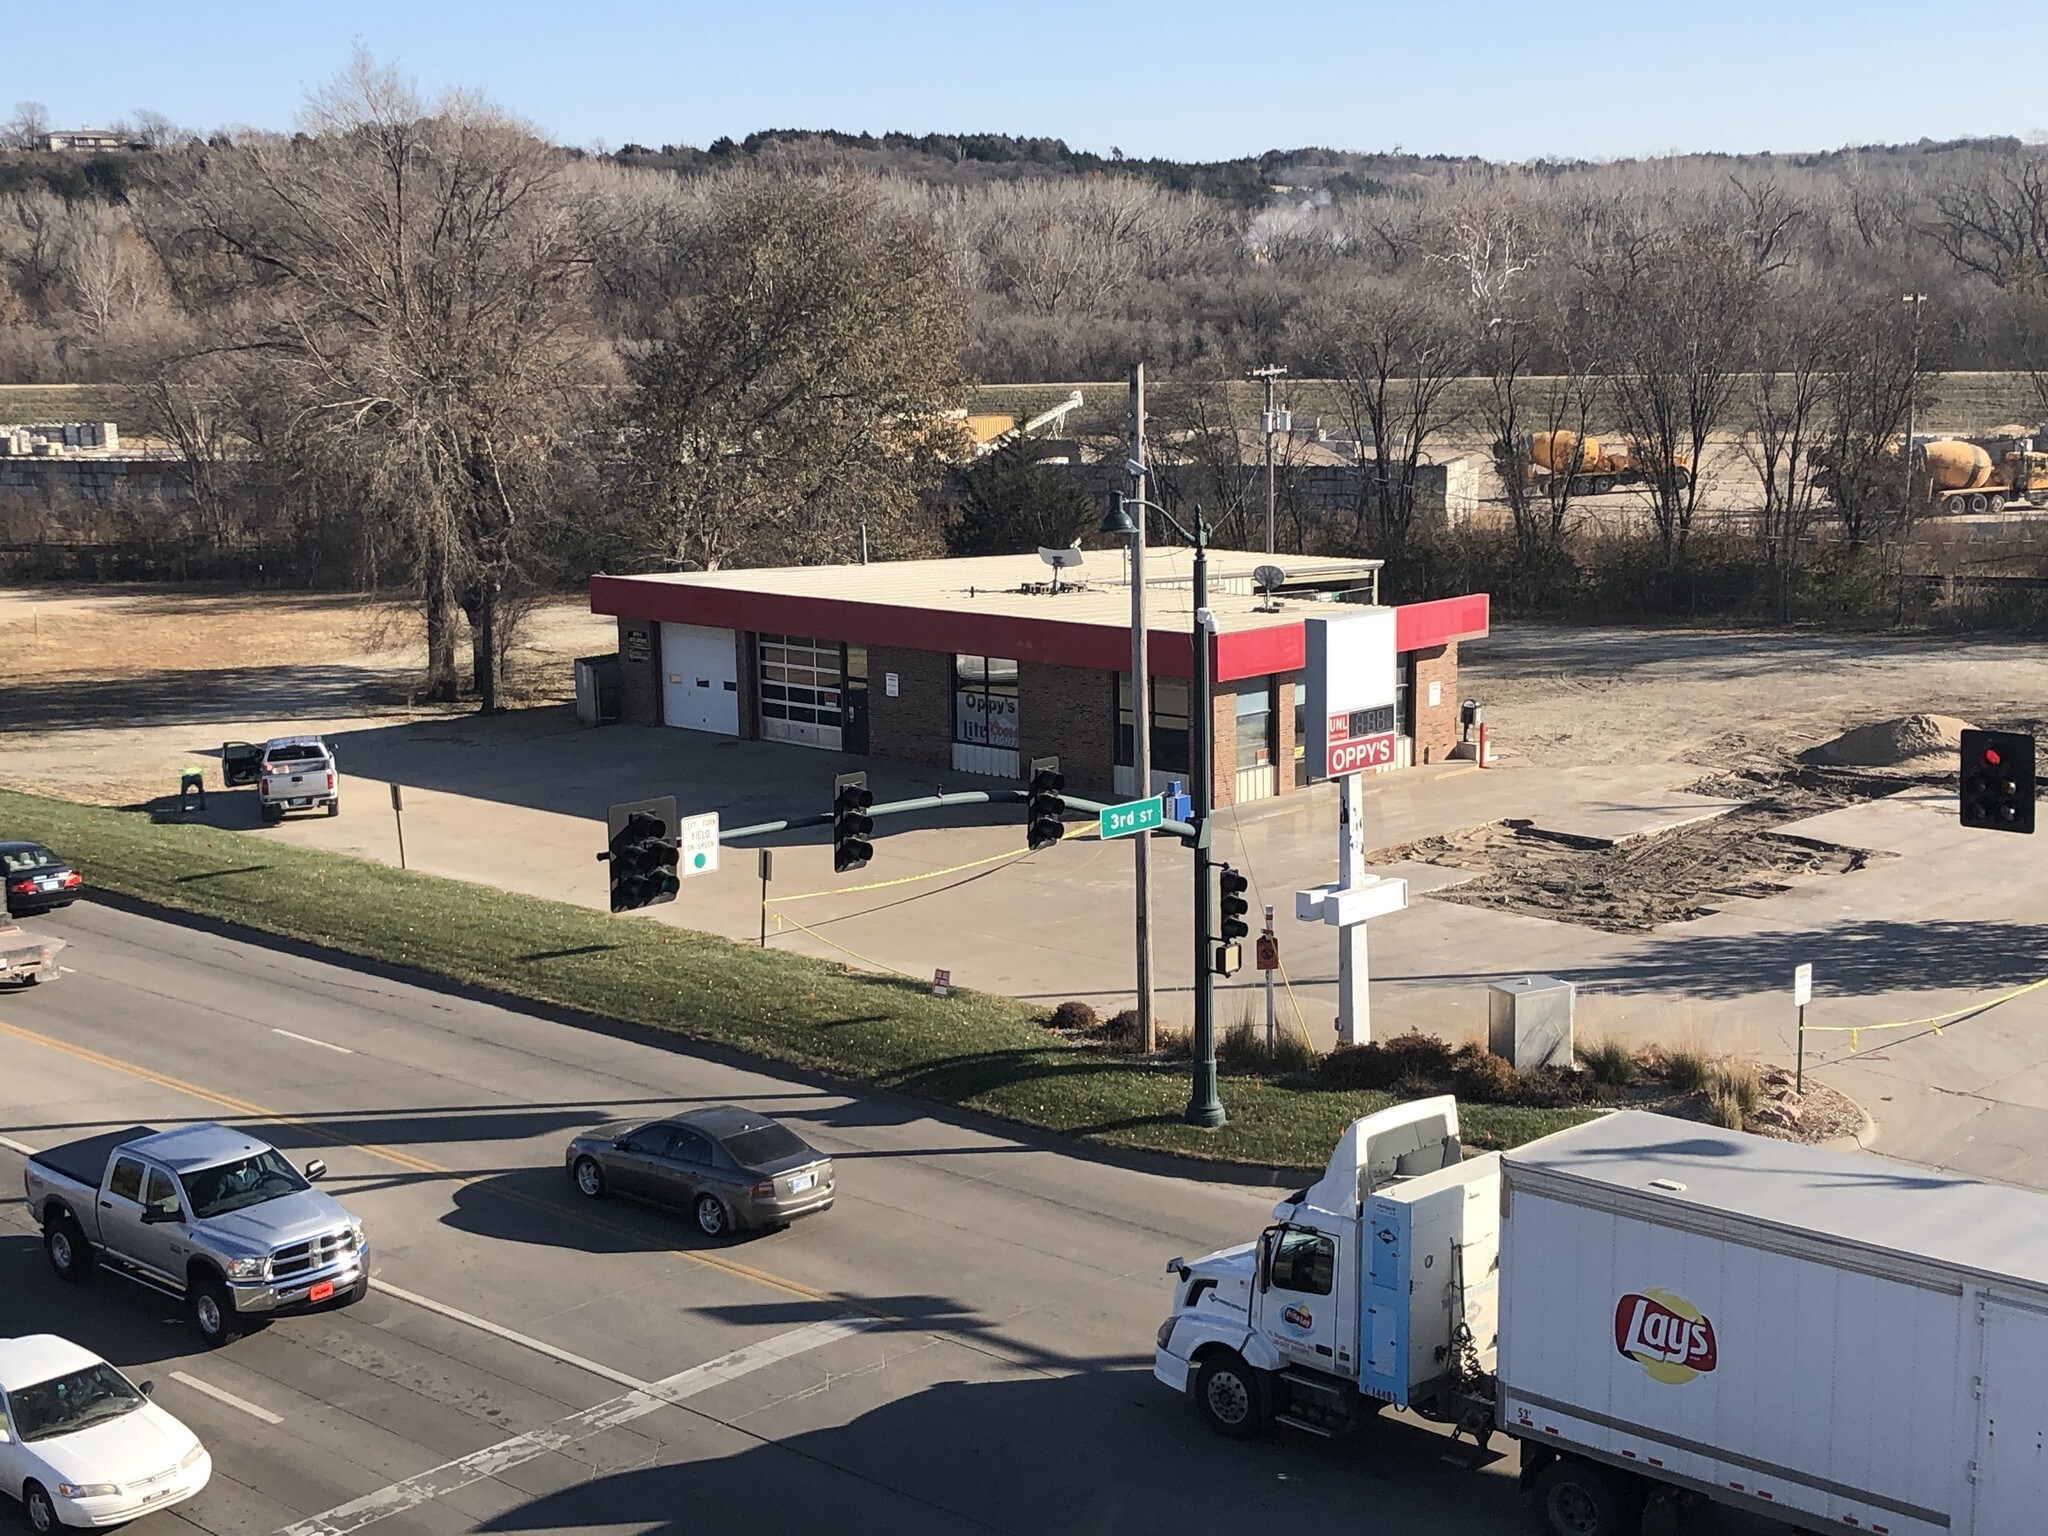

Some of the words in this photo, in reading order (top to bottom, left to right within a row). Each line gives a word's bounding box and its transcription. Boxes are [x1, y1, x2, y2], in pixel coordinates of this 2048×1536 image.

[966, 693, 1016, 715] Oppy's
[1329, 716, 1348, 733] UNL
[1332, 738, 1391, 771] OPPY'S
[1110, 810, 1135, 830] 3rd
[1139, 808, 1154, 823] ST
[690, 829, 710, 841] YIELD
